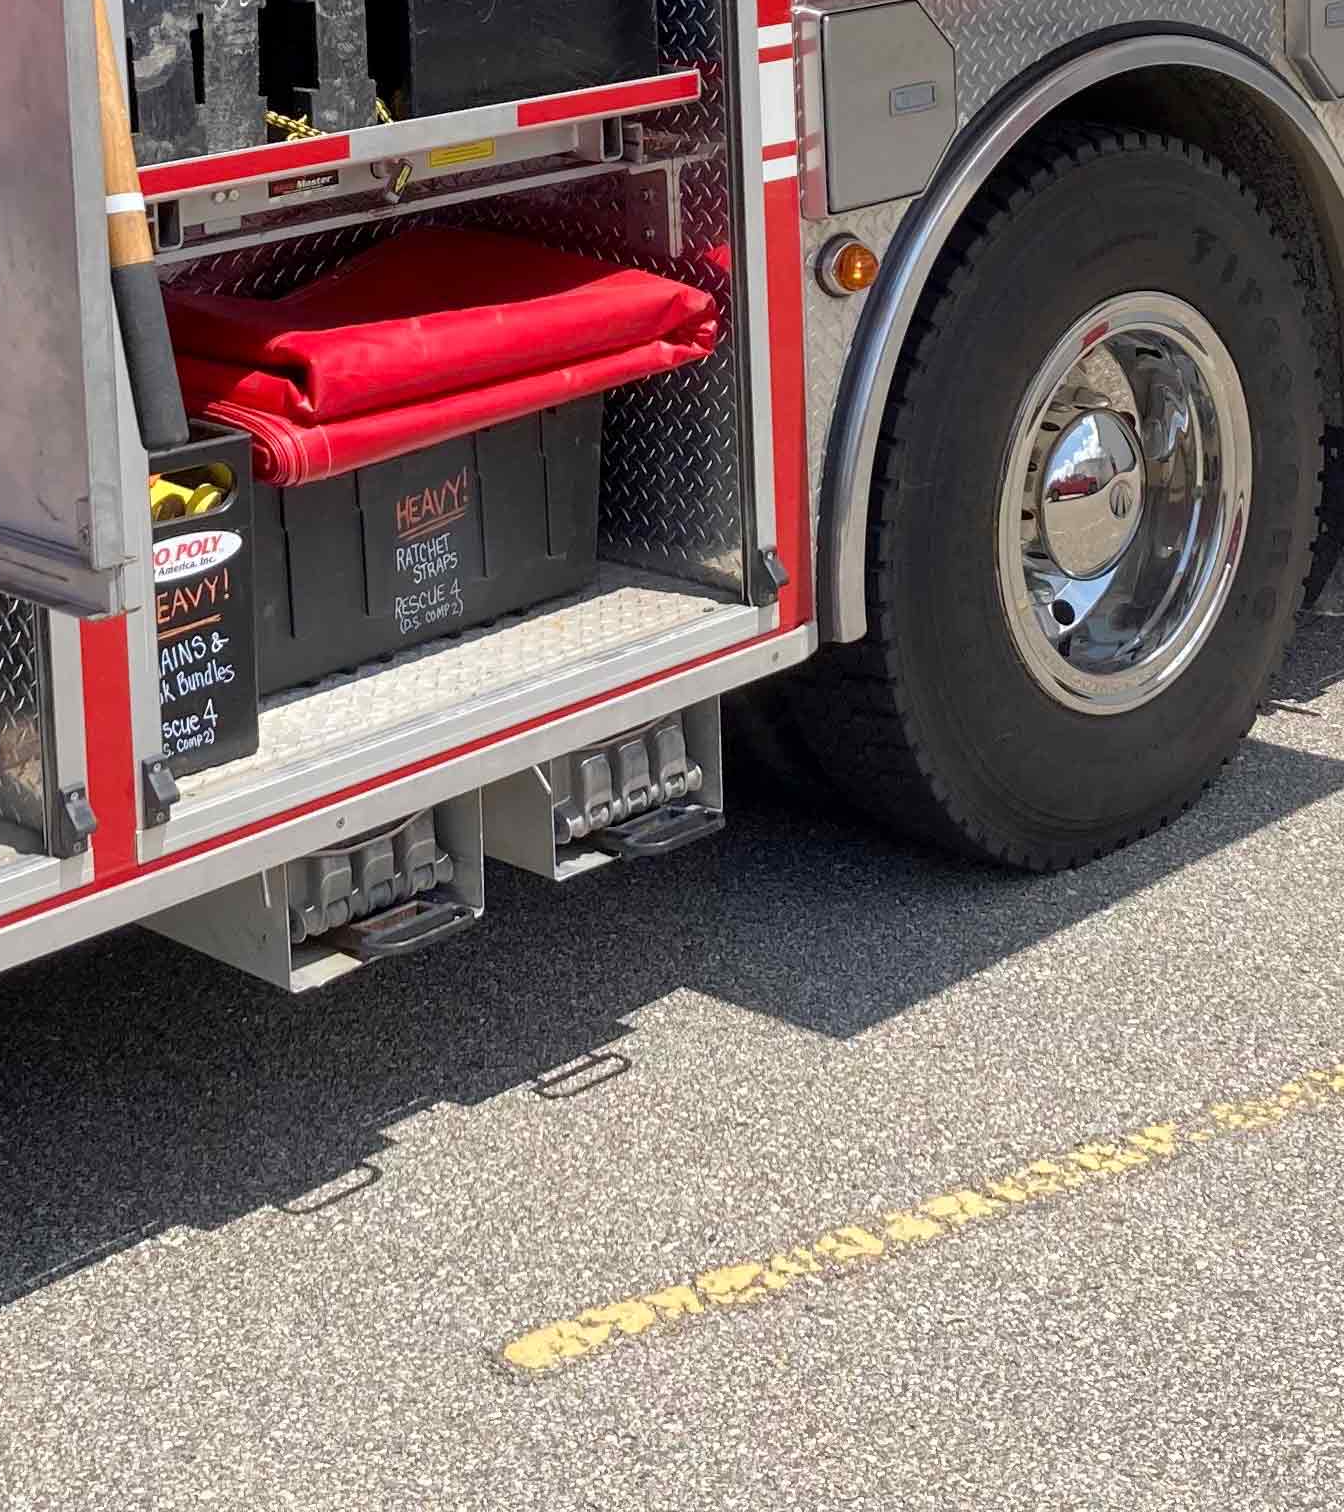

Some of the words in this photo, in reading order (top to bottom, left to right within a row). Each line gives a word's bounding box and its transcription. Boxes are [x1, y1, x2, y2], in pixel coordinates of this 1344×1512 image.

[396, 465, 468, 530] HEAVY!
[176, 533, 224, 561] POLY
[396, 533, 450, 572] RATCHET
[413, 551, 458, 584] STRAPS
[157, 567, 230, 625] EAVY!
[394, 583, 446, 620] RESCUE
[449, 577, 462, 602] 4
[160, 635, 207, 676] AINS
[211, 631, 230, 654] &
[176, 658, 236, 696] Bundles
[162, 714, 201, 739] scue
[203, 697, 218, 728] 4
